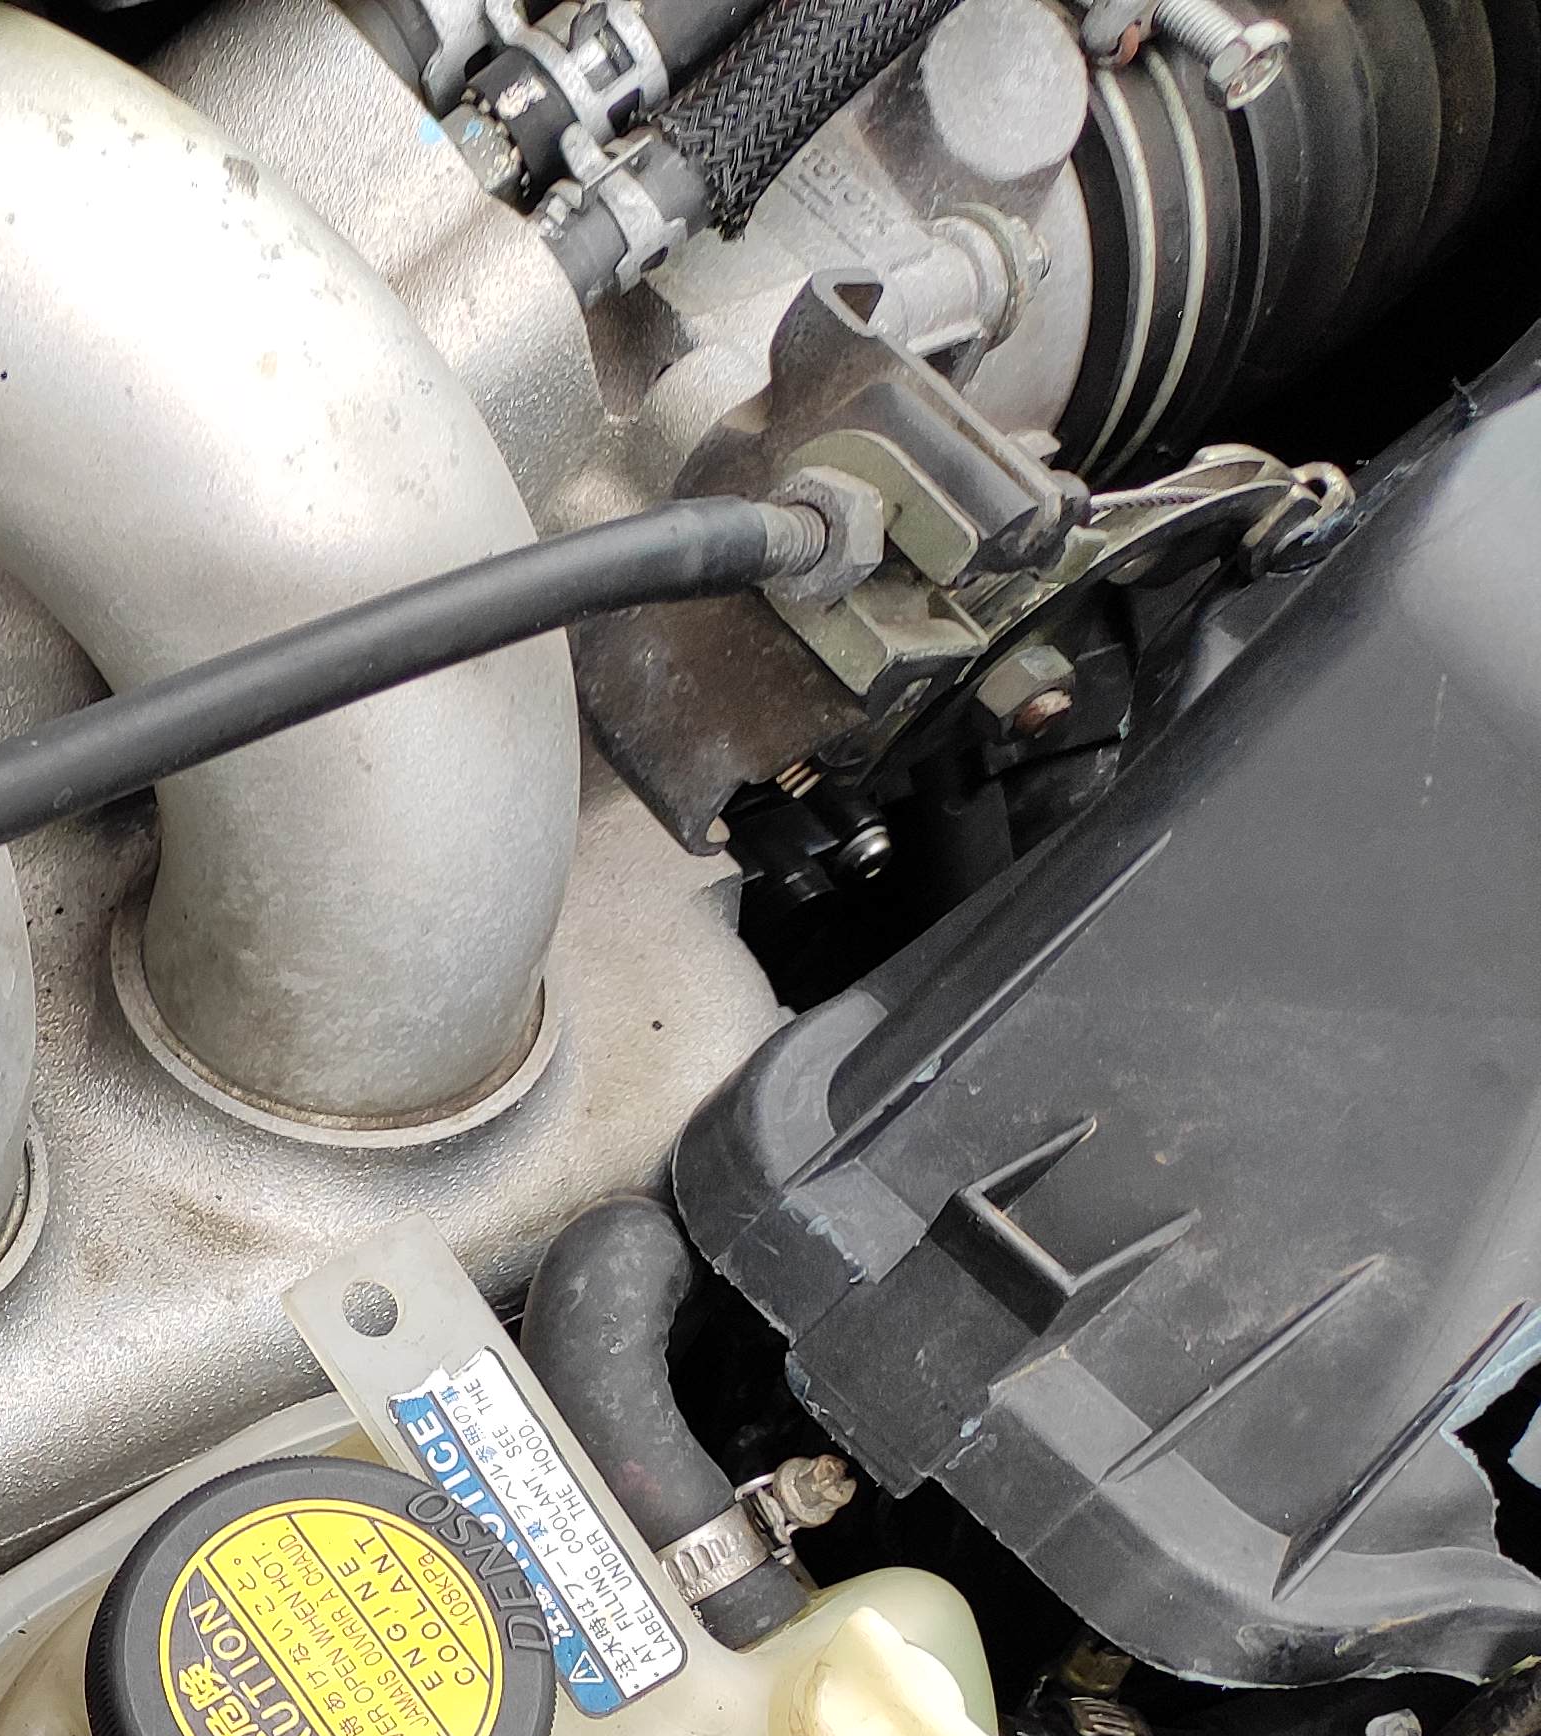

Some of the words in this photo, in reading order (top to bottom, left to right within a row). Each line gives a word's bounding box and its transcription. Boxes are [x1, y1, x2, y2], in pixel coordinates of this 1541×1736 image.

[462, 1377, 494, 1414] THE
[491, 1423, 522, 1459] SEE
[555, 1482, 586, 1518] THE
[406, 1491, 558, 1649] DENSO
[412, 1548, 479, 1629] 108kPa
[585, 1528, 634, 1591] UNDER
[283, 1588, 335, 1650] WHEN
[336, 1554, 444, 1694] ENGINE
[353, 1527, 478, 1690] COOLANT
[582, 1563, 634, 1631] FILLING
[631, 1598, 677, 1657] LABEL
[329, 1603, 384, 1669] OUVRIR
[631, 1639, 657, 1667] AT
[324, 1645, 376, 1706] OPEN
[375, 1667, 430, 1733] JAMAIS
